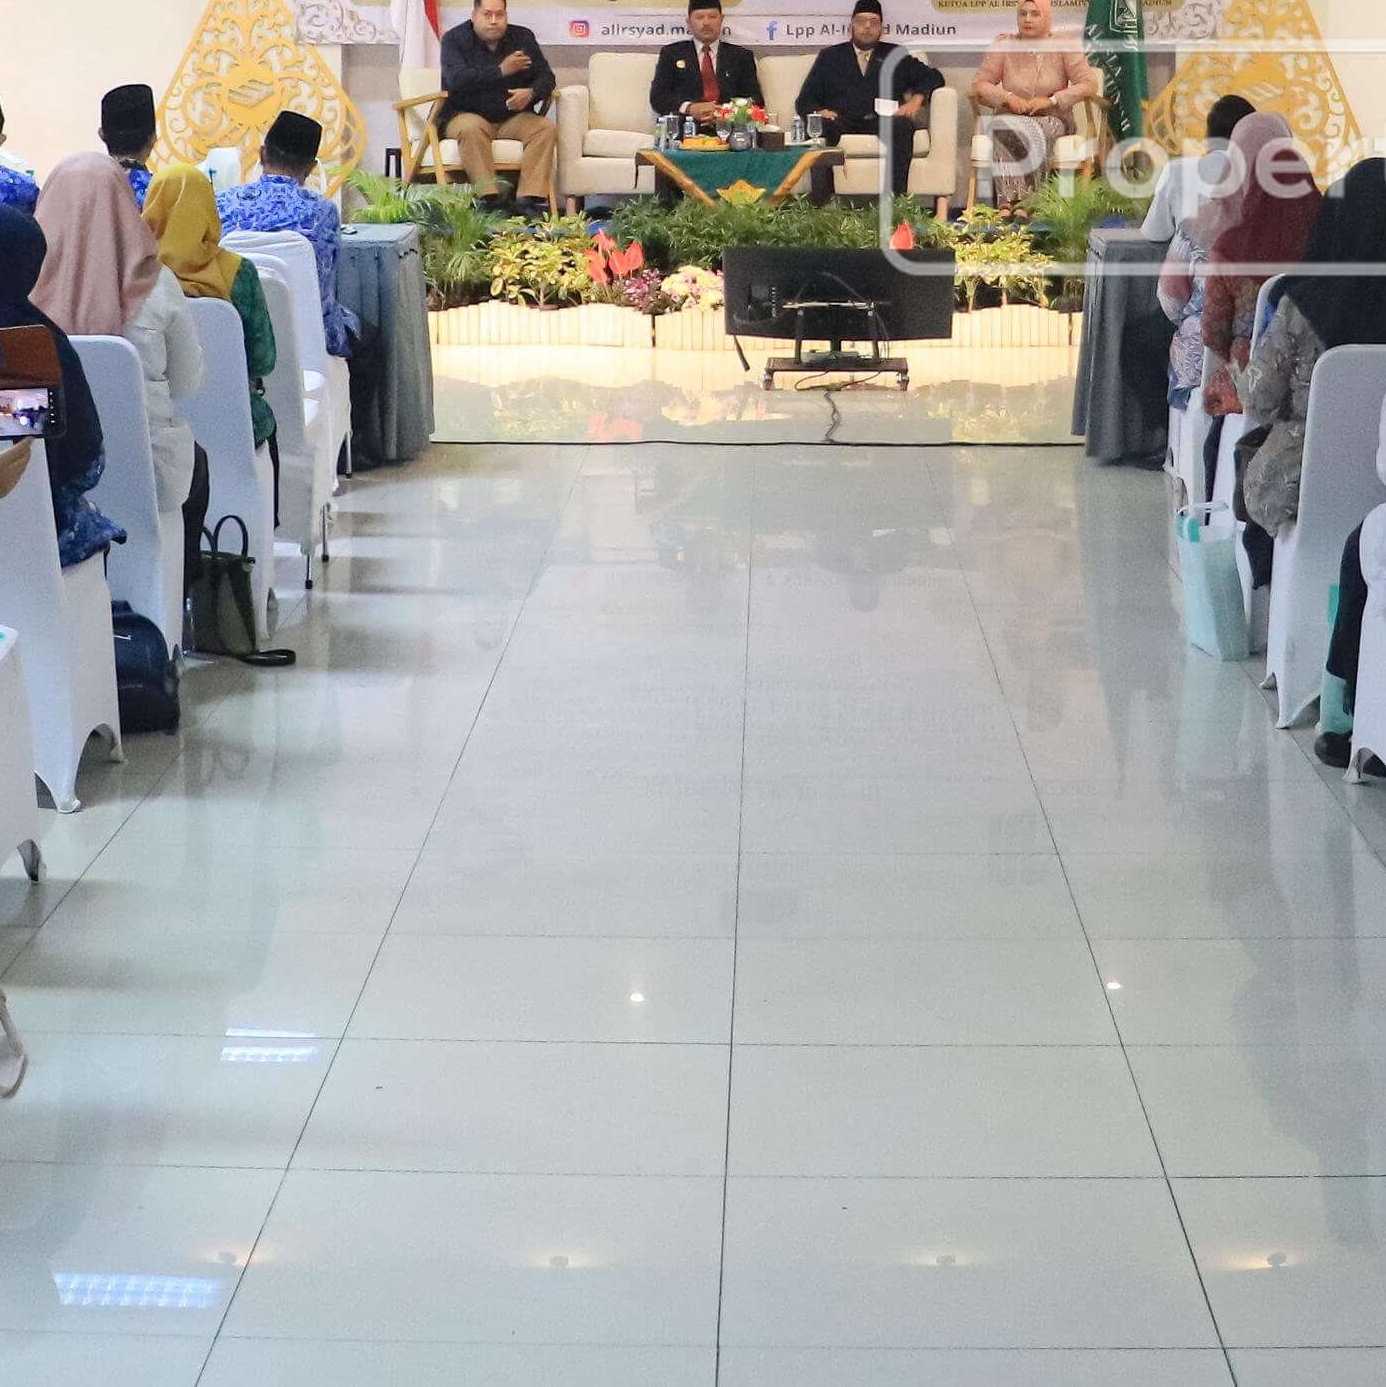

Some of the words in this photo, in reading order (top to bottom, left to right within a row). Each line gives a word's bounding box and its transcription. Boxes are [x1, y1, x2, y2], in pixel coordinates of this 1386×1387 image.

[938, 0, 967, 8] KETUA
[601, 23, 731, 39] alirsyad.man
[786, 23, 815, 38] Lpp
[896, 23, 956, 35] Madiun
